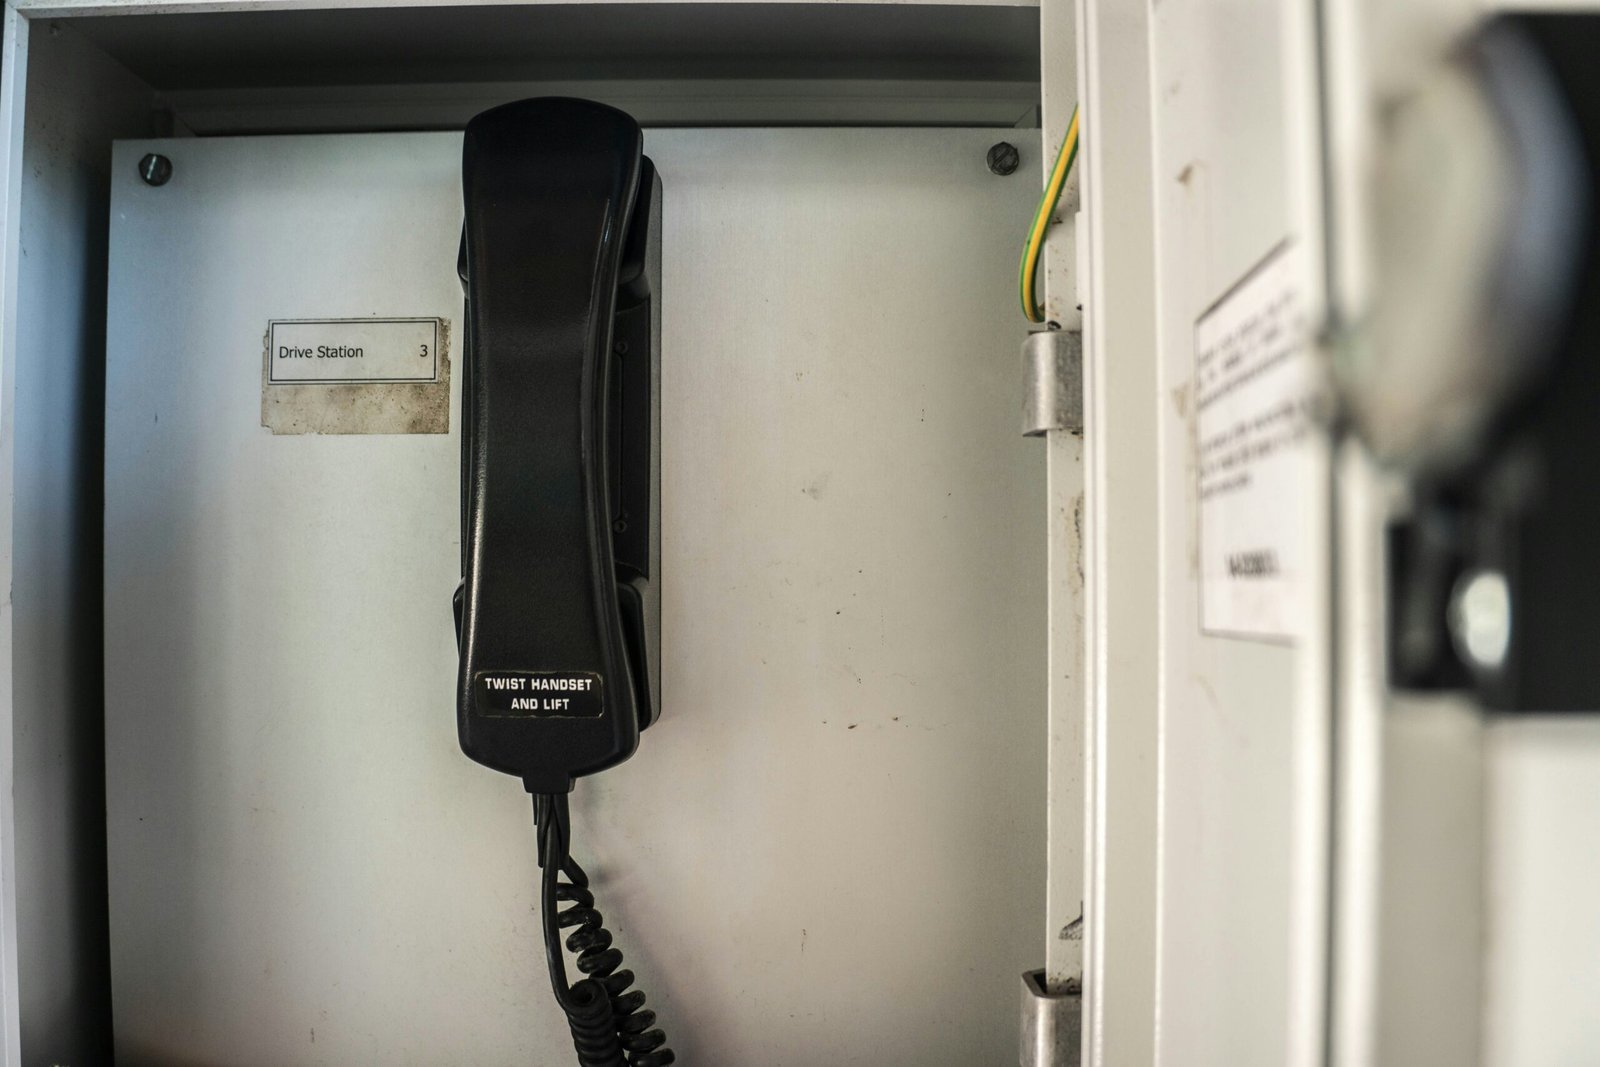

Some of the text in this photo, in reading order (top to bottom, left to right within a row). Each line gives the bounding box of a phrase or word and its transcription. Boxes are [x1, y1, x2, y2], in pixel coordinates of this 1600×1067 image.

[279, 344, 429, 358] Drive Station 3
[485, 677, 592, 691] TWIST HANDSET
[511, 697, 570, 710] AND LIFT
